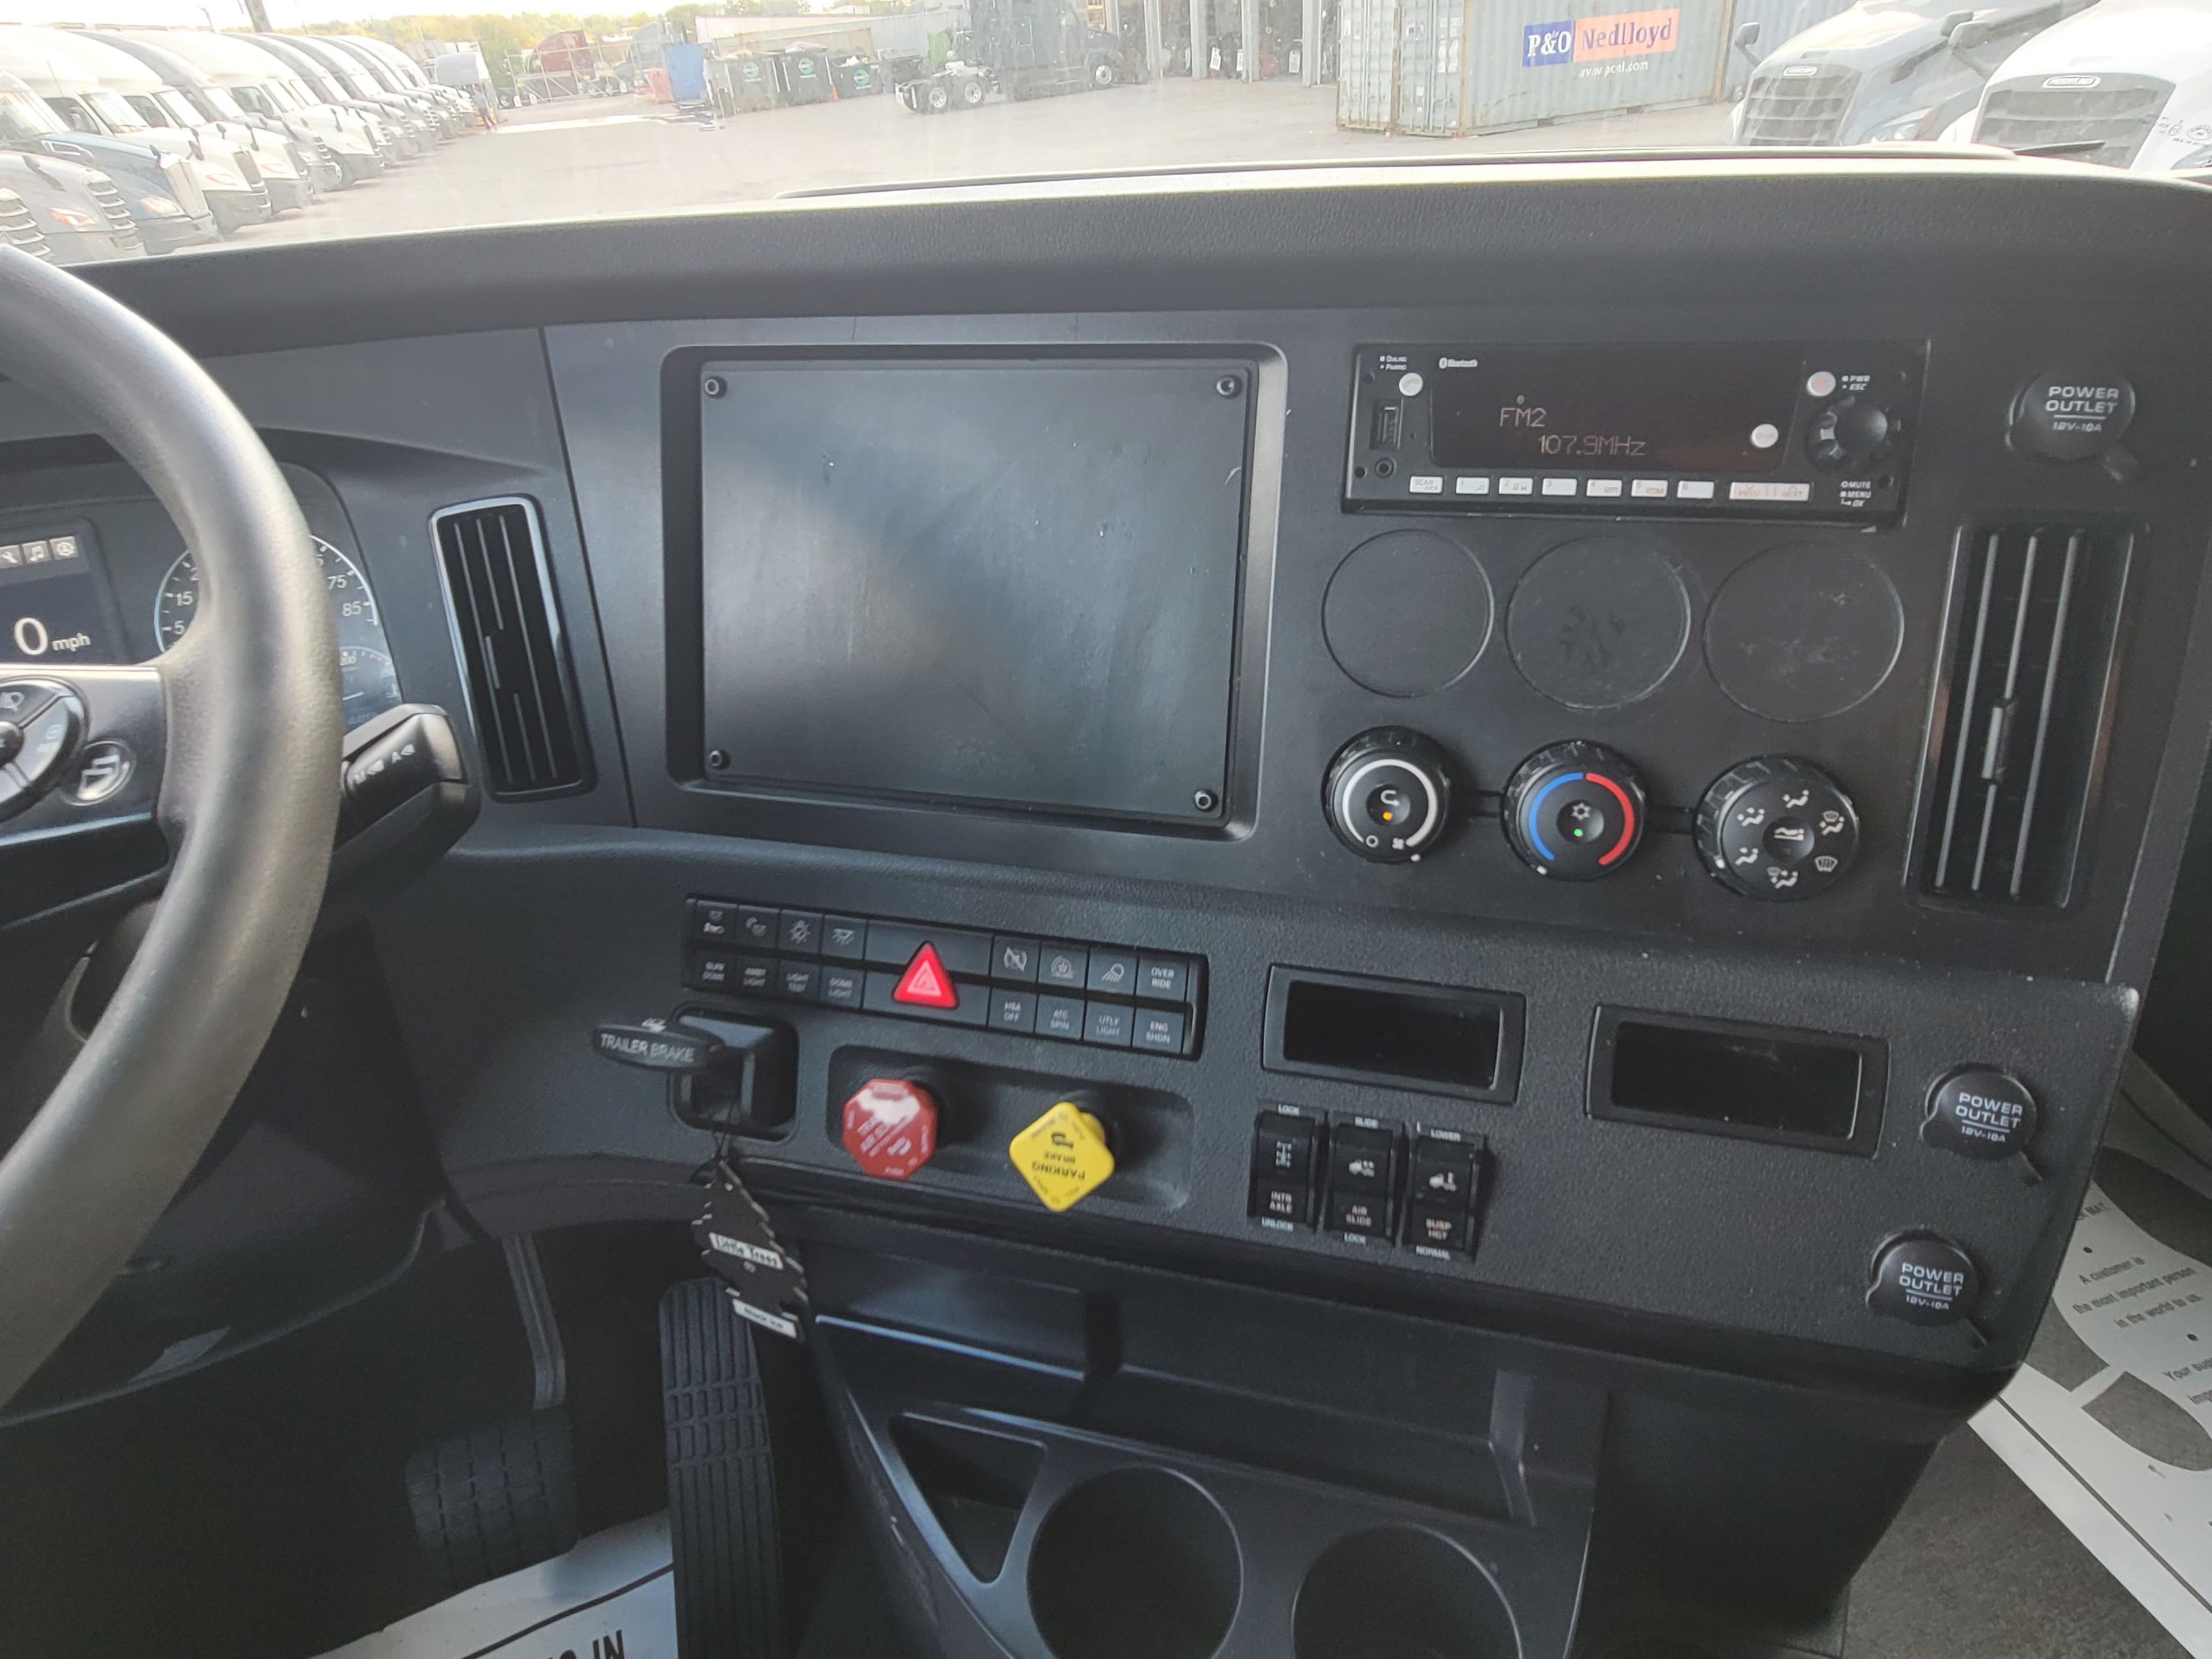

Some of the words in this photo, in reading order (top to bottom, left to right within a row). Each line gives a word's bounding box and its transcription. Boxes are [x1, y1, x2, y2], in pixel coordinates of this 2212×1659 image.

[1527, 31, 1571, 57] P&O
[1582, 18, 1672, 51] Nedlloyd
[2049, 386, 2119, 399] POWER
[2046, 400, 2118, 414] OUTLET
[1499, 408, 1547, 427] FM2
[1538, 434, 1646, 456] 107.9MHz
[327, 574, 347, 590] 75
[176, 591, 193, 606] 15
[342, 601, 362, 616] 85
[174, 620, 185, 635] 5
[52, 632, 91, 652] mph
[1151, 966, 1175, 978] OVER
[1151, 978, 1171, 990] RIDE
[1004, 1012, 1020, 1024] OFF
[1050, 1020, 1069, 1031] SPIN
[1096, 1025, 1120, 1036] LIGHT
[1150, 1020, 1168, 1032] ENG
[600, 1033, 648, 1056] TRAILER
[650, 1043, 695, 1063] BRAKE
[1278, 1104, 1300, 1116] LOCK
[1959, 1092, 2023, 1116] POWER
[1956, 1105, 2021, 1129] OUTLET
[1430, 1128, 1461, 1142] LOWER
[1032, 1161, 1086, 1181] PARKING
[1262, 1216, 1294, 1232] UNLOCK
[1344, 1231, 1367, 1245] LOCK
[1902, 1262, 1964, 1285] POWER
[2079, 1275, 2092, 1285] A
[2089, 1260, 2132, 1281] customer
[1899, 1275, 1963, 1297] OUTLET
[2072, 1303, 2093, 1315] the
[2091, 1294, 2119, 1308] most
[2115, 1278, 2164, 1299] important
[2162, 1267, 2198, 1286] person
[2113, 1319, 2130, 1329] in
[2126, 1313, 2146, 1324] the
[2144, 1301, 2175, 1317] world
[2171, 1298, 2187, 1308] to
[2162, 1367, 2191, 1381] Your
